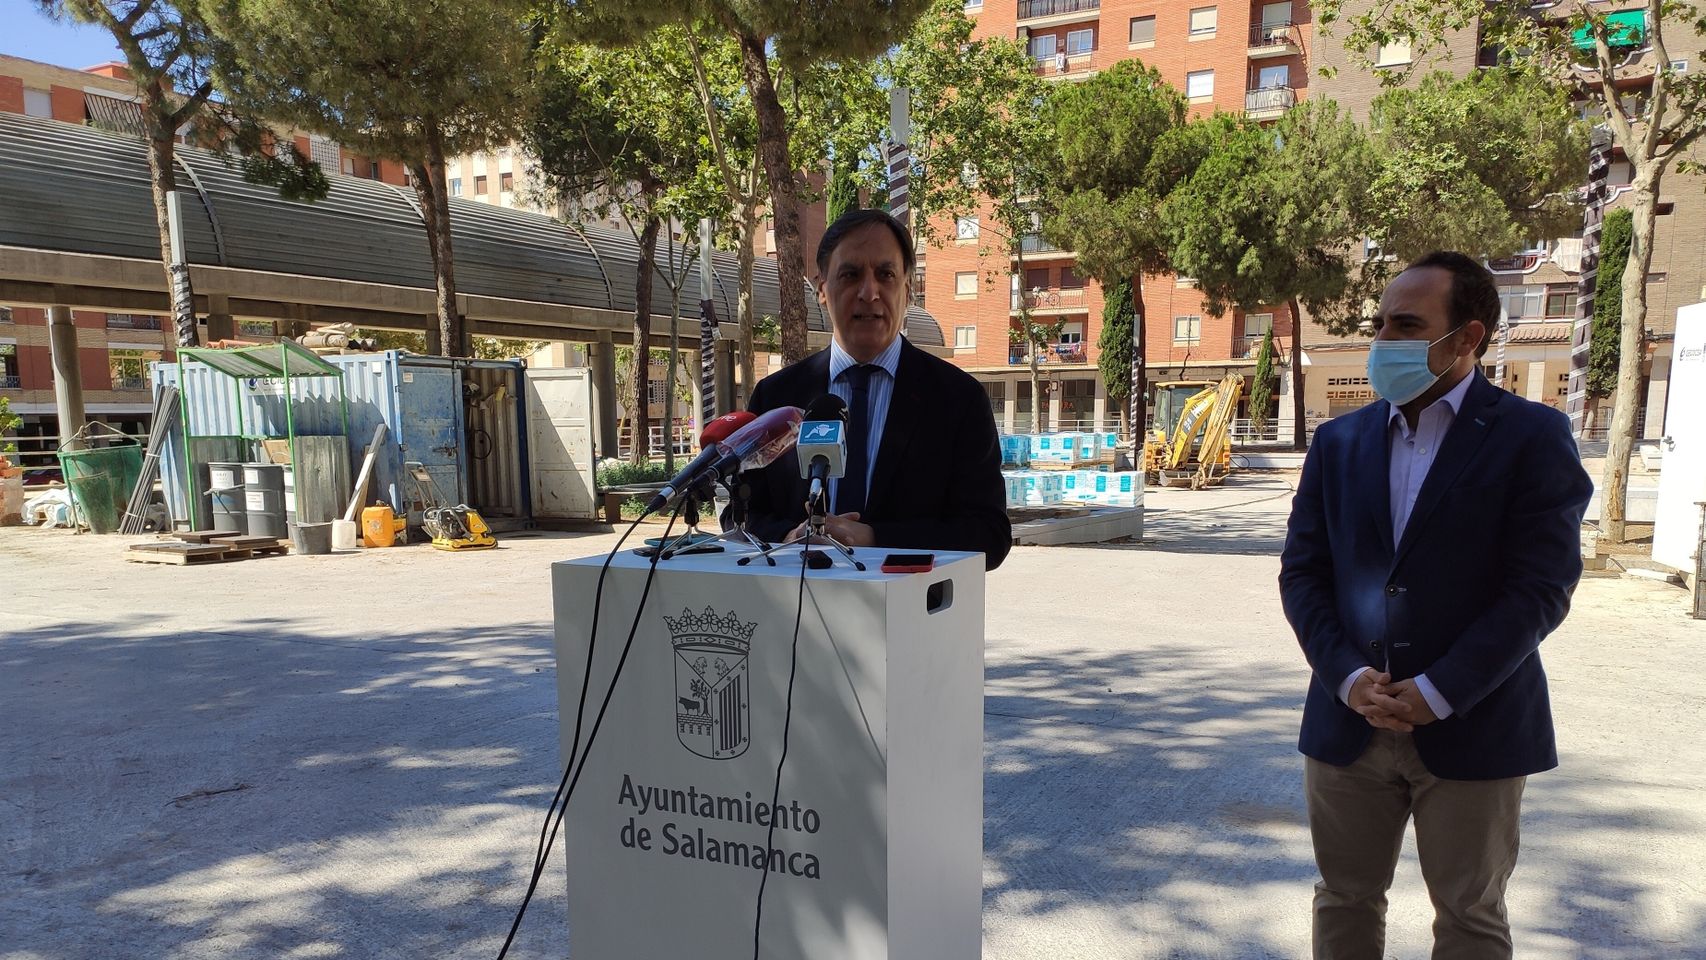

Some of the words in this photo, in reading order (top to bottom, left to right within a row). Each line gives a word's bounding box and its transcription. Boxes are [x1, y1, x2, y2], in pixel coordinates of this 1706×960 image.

[618, 774, 821, 834] Ayuntamiento
[620, 817, 652, 851] de
[662, 822, 821, 880] Salamanca
